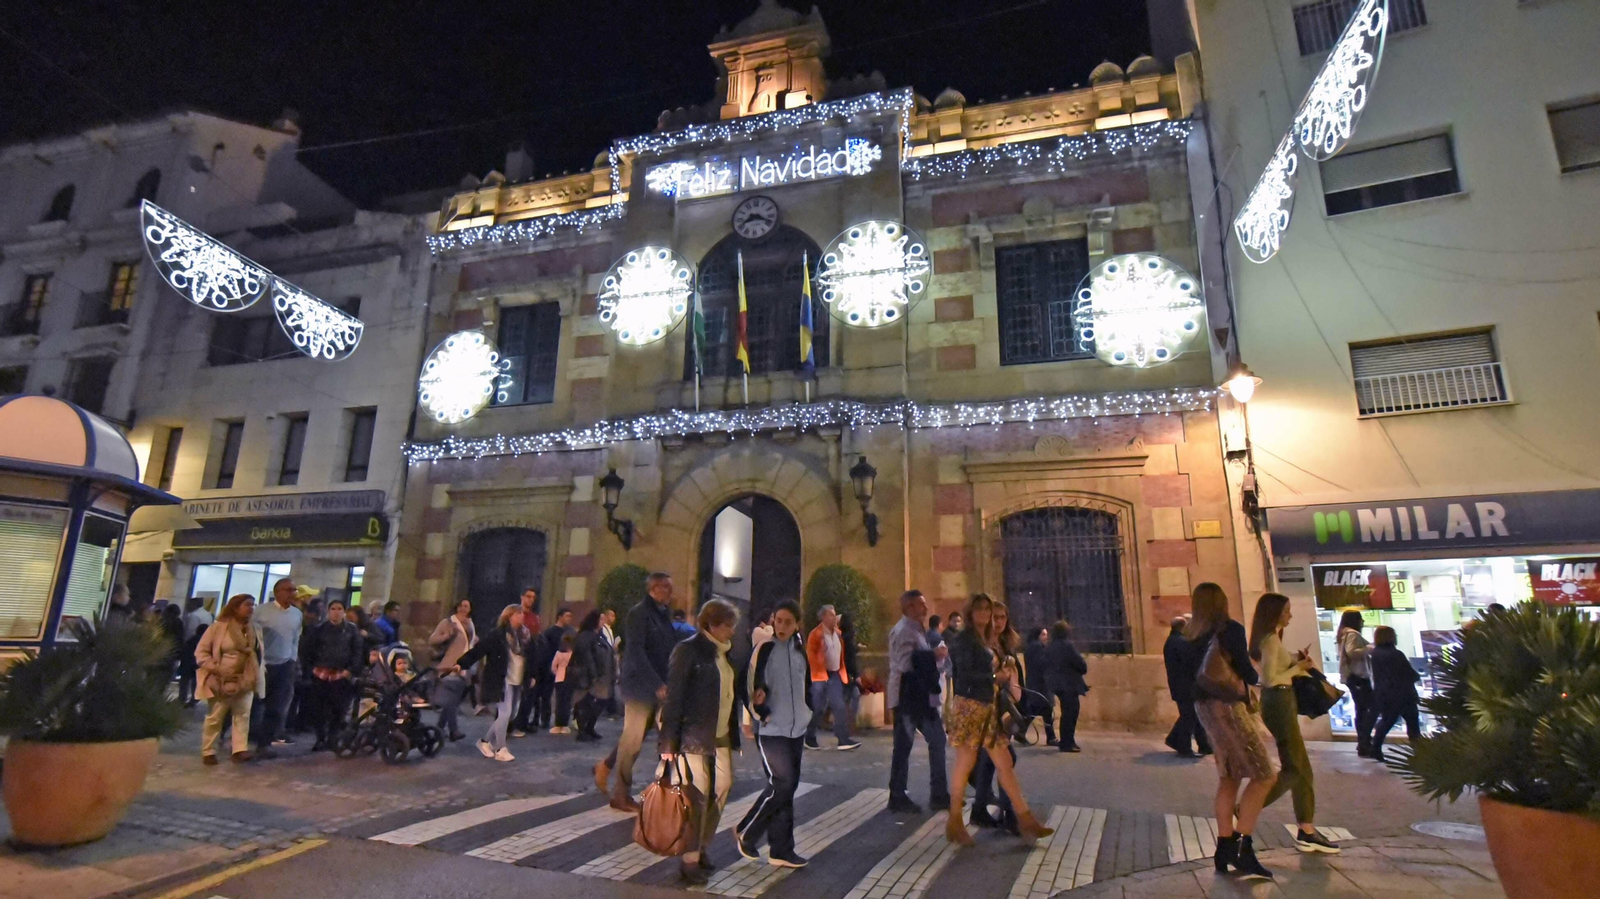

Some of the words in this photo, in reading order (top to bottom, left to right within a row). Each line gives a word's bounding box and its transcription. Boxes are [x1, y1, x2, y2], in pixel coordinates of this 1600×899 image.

[674, 161, 732, 198] Feliz
[740, 139, 852, 188] Navidad
[184, 501, 225, 514] ABINETE
[227, 500, 241, 513] DE
[246, 499, 295, 512] ASESORIA
[1357, 501, 1510, 542] MILAR
[1323, 569, 1372, 586] BLACK
[1540, 562, 1598, 582] BLACK
[1390, 581, 1406, 594] 20
